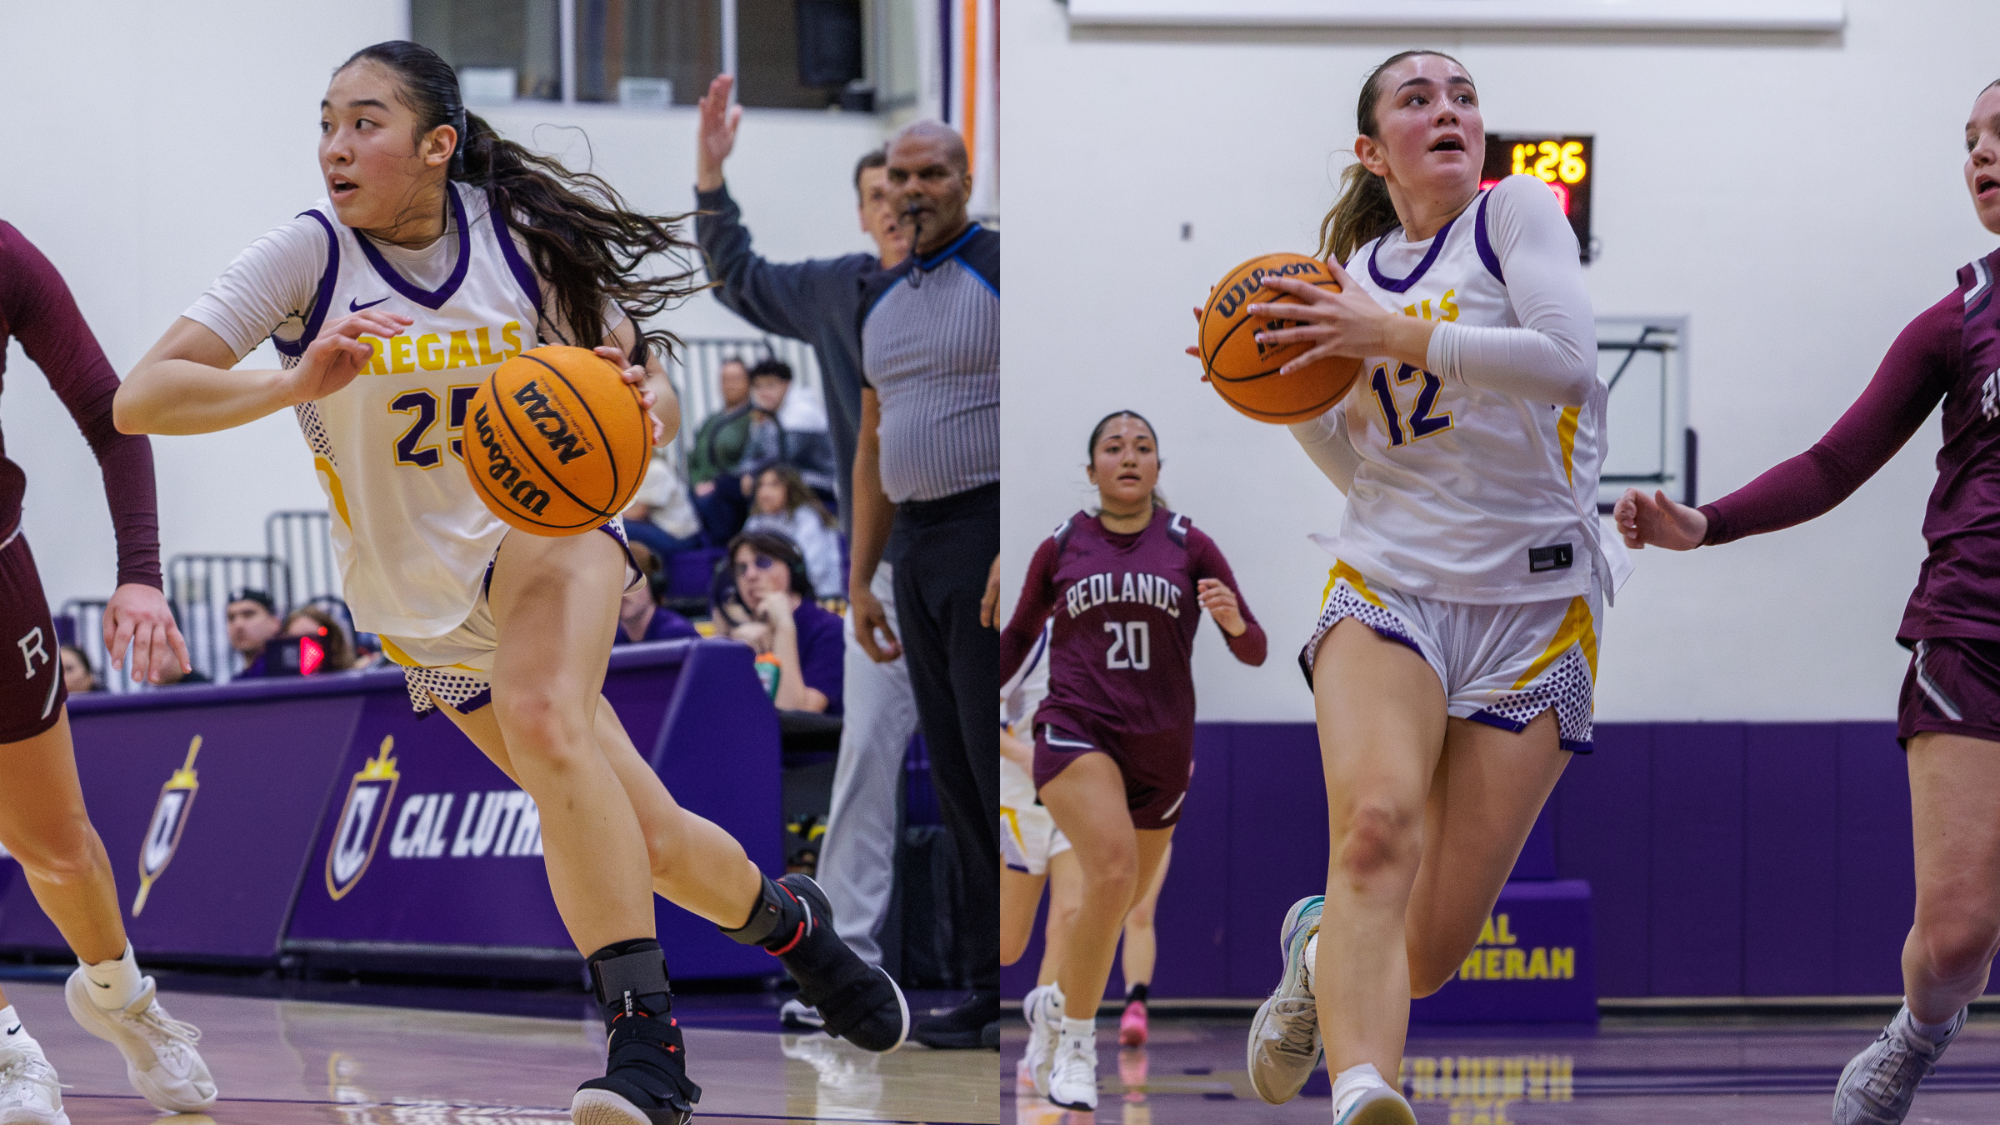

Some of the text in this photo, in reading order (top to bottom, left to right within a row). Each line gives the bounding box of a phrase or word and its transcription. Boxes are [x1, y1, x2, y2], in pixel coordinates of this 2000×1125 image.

[1511, 141, 1586, 183] 1:26
[1215, 262, 1321, 318] Wilson
[356, 320, 522, 375] REGALS
[513, 380, 588, 465] NCAA
[1369, 361, 1454, 449] 12
[475, 402, 551, 516] Wilson
[1066, 572, 1182, 619] REDLANDS
[17, 626, 49, 679] R
[1103, 621, 1150, 670] 20
[389, 793, 455, 859] CAL
